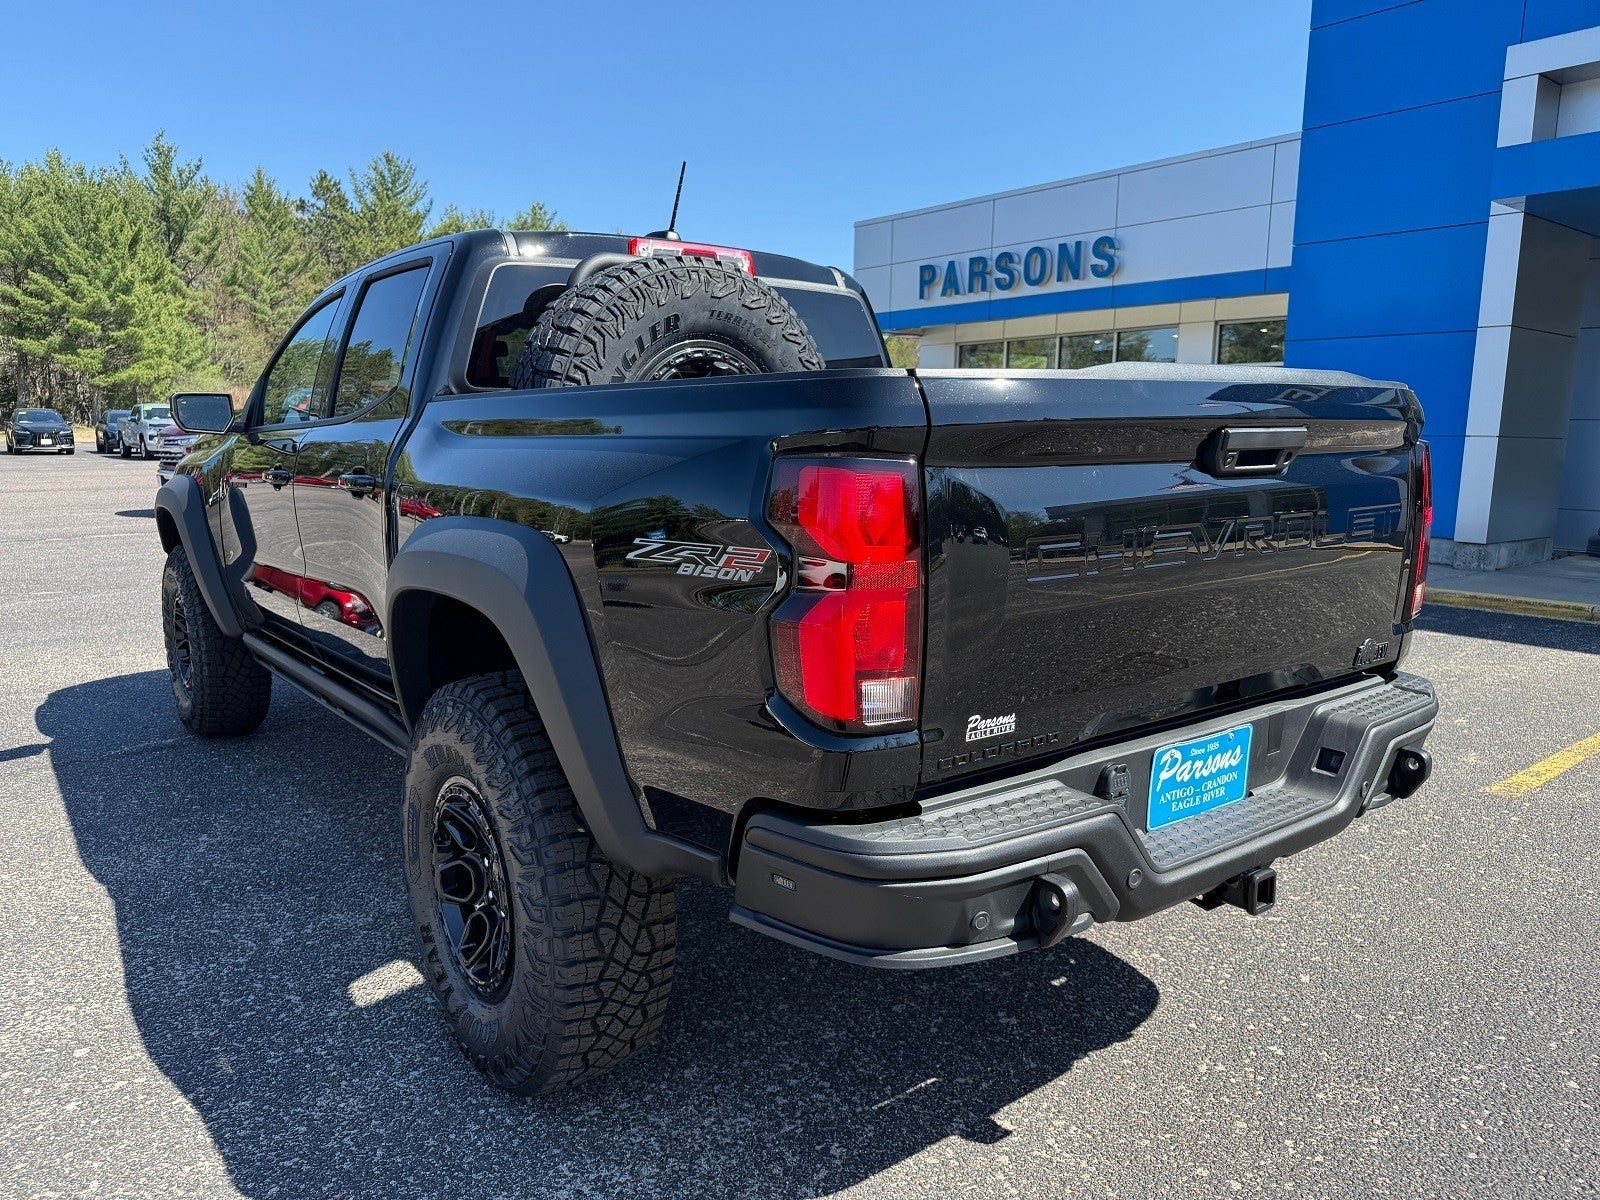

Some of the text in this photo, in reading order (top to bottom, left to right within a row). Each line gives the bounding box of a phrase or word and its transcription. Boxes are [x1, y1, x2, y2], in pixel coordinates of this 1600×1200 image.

[919, 235, 1120, 300] PARSONS
[626, 537, 772, 573] ZR2
[1025, 503, 1402, 583] CHEVROLET
[676, 562, 755, 582] BISON
[966, 712, 1016, 732] Parsons
[937, 731, 1060, 769] COLORADO
[1156, 745, 1243, 792] Parsons
[1159, 785, 1194, 804] ANTIGO
[1201, 771, 1239, 792] CRANDON
[1171, 786, 1226, 812] EAGLE RIVER
